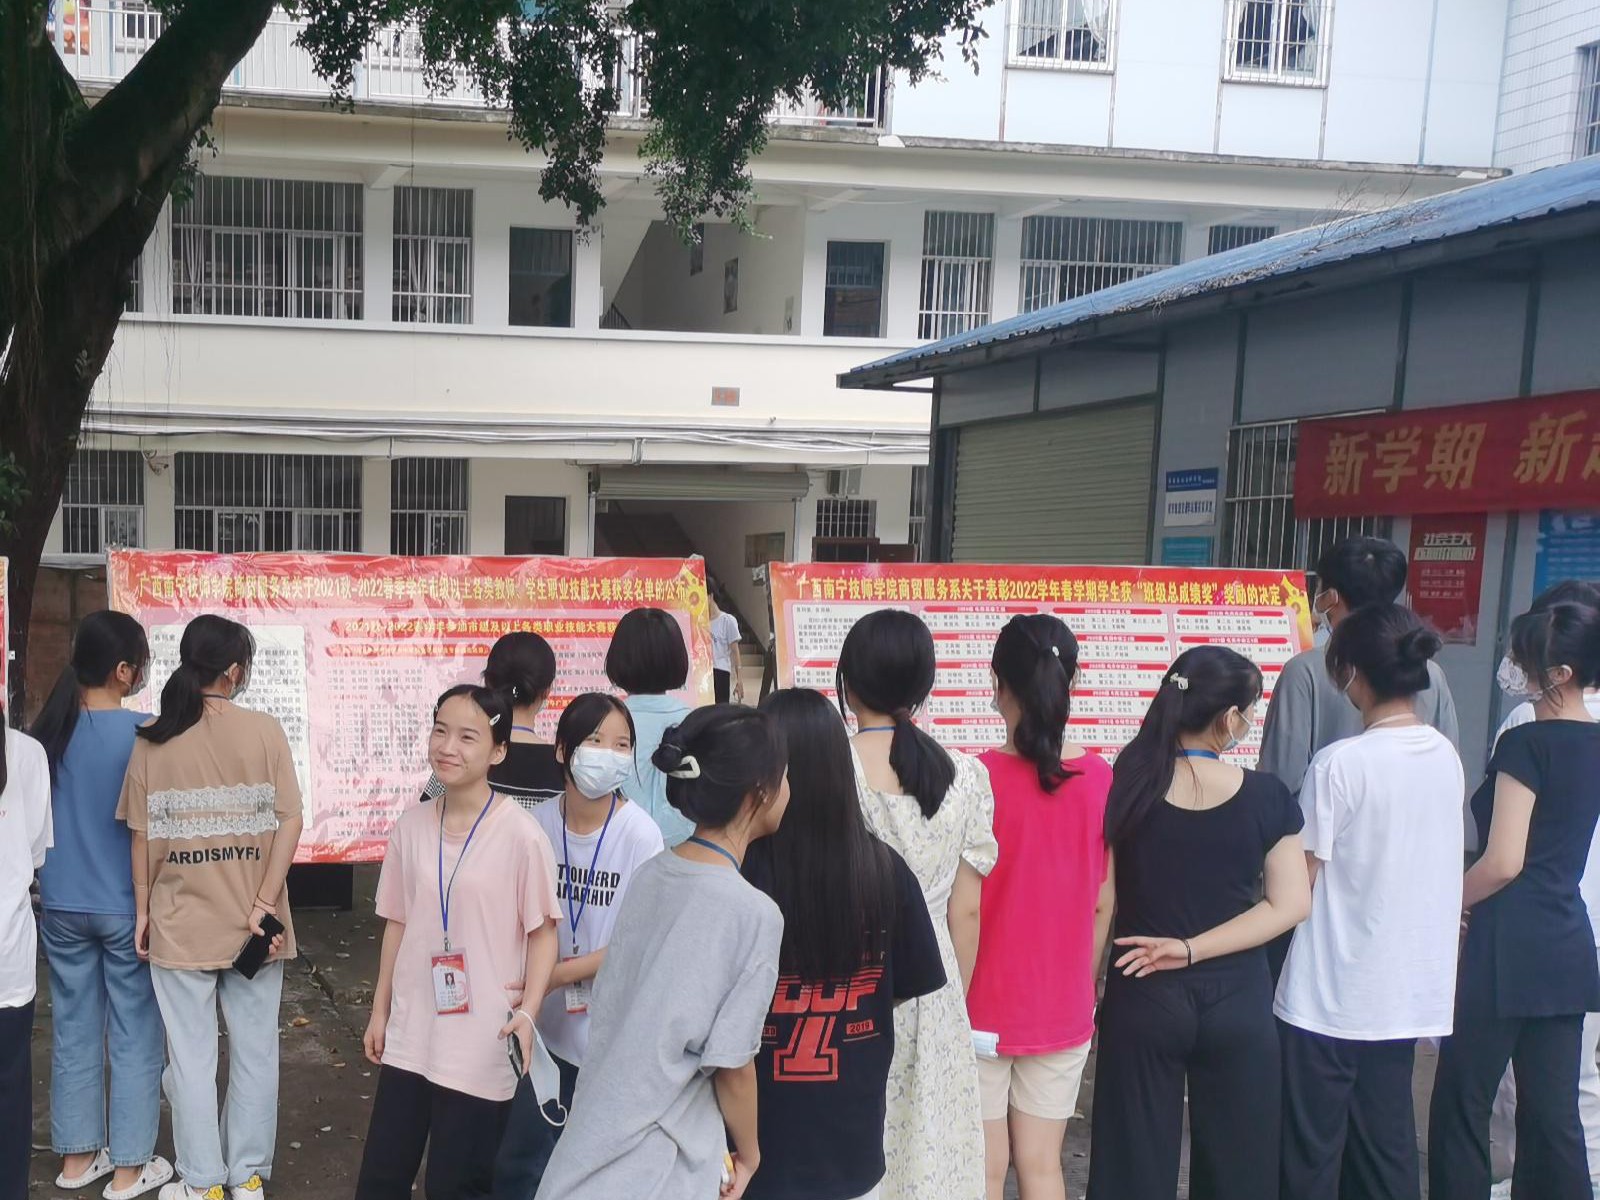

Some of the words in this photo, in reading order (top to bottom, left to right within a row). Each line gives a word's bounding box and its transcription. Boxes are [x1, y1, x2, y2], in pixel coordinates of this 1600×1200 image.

[1323, 423, 1487, 495] 新学期
[849, 1020, 870, 1033] 2019
